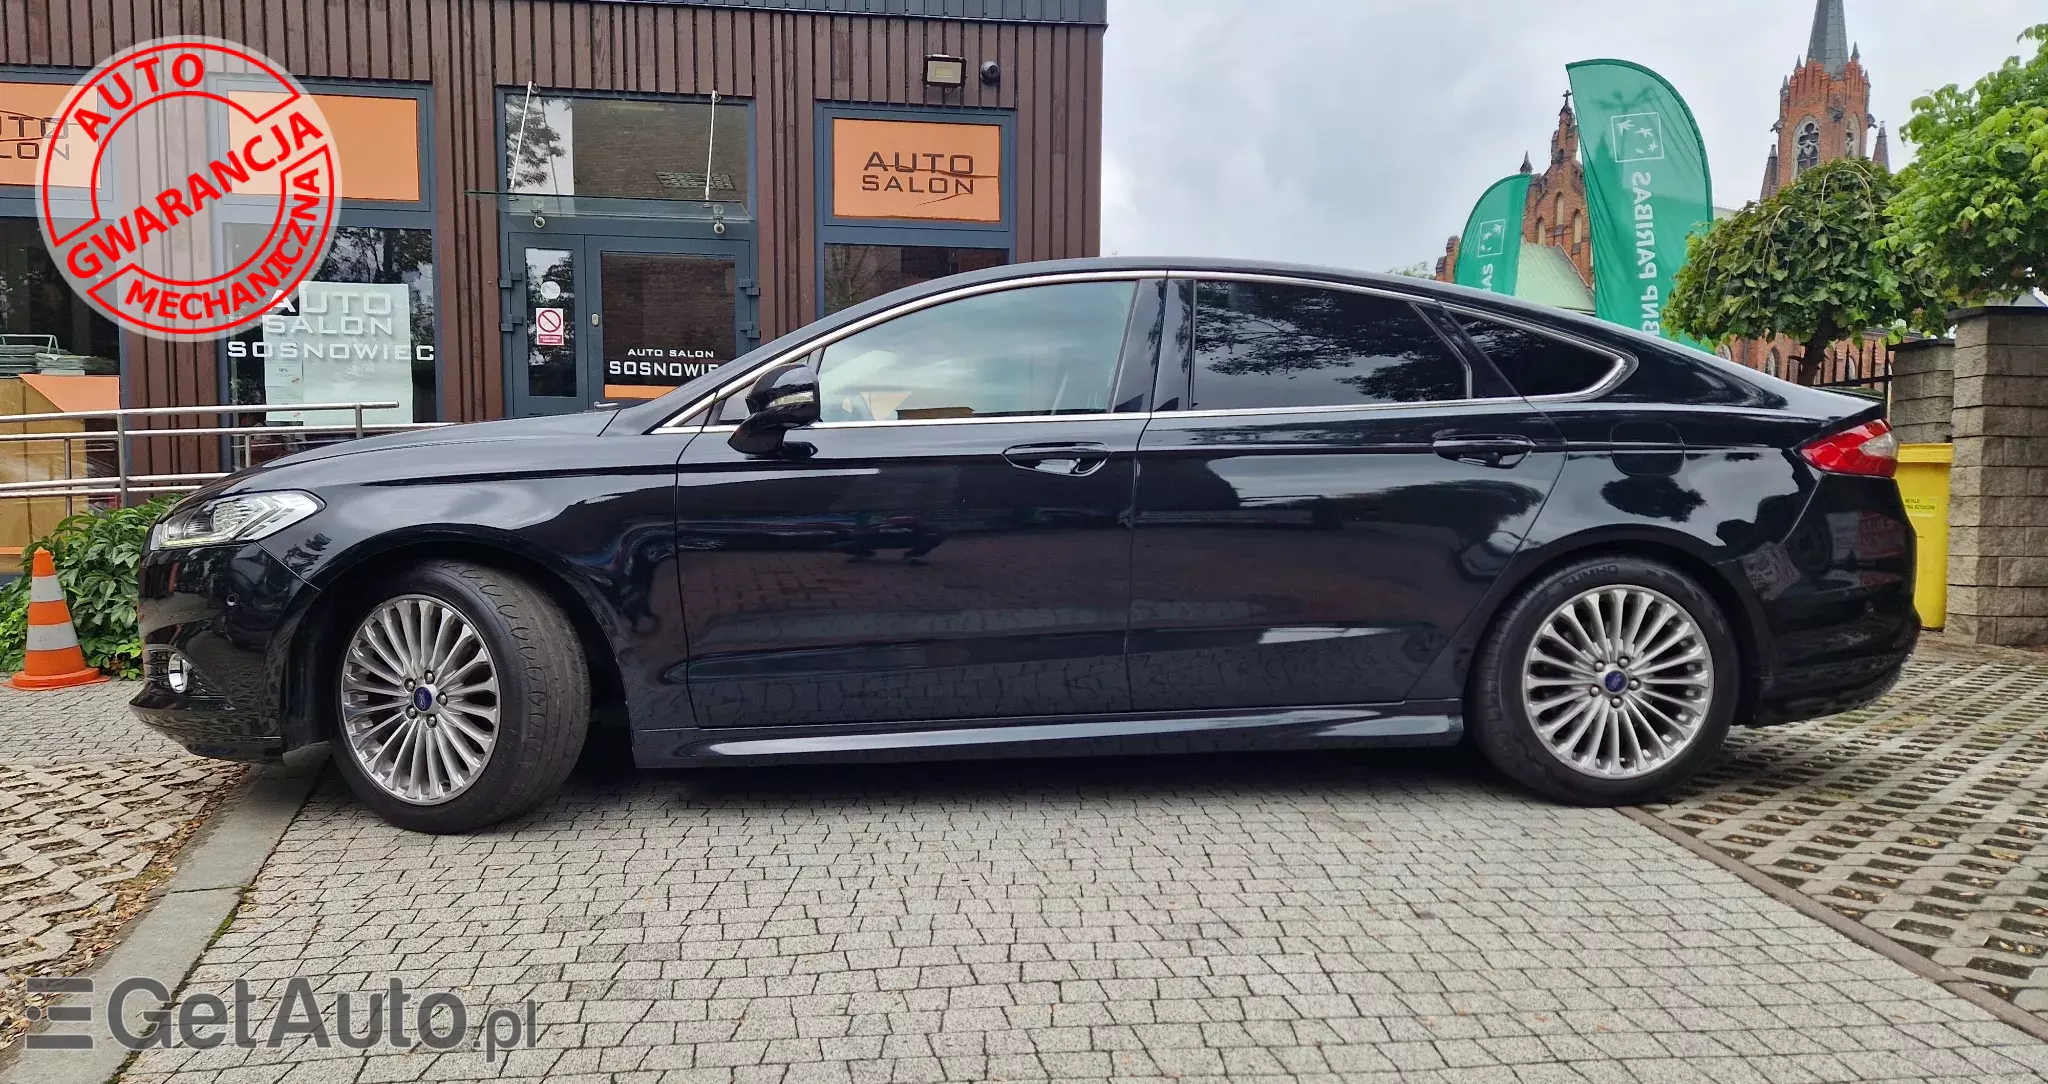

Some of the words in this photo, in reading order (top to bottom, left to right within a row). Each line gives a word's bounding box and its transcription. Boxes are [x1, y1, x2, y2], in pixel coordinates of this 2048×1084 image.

[0, 116, 69, 139] TO
[863, 151, 974, 174] AUTO
[861, 175, 974, 195] SALON
[268, 289, 392, 315] AUTO
[265, 314, 393, 336] SALON
[227, 341, 435, 361] SOSNOWIEC
[627, 348, 664, 357] AUTO
[669, 349, 715, 358] SALON
